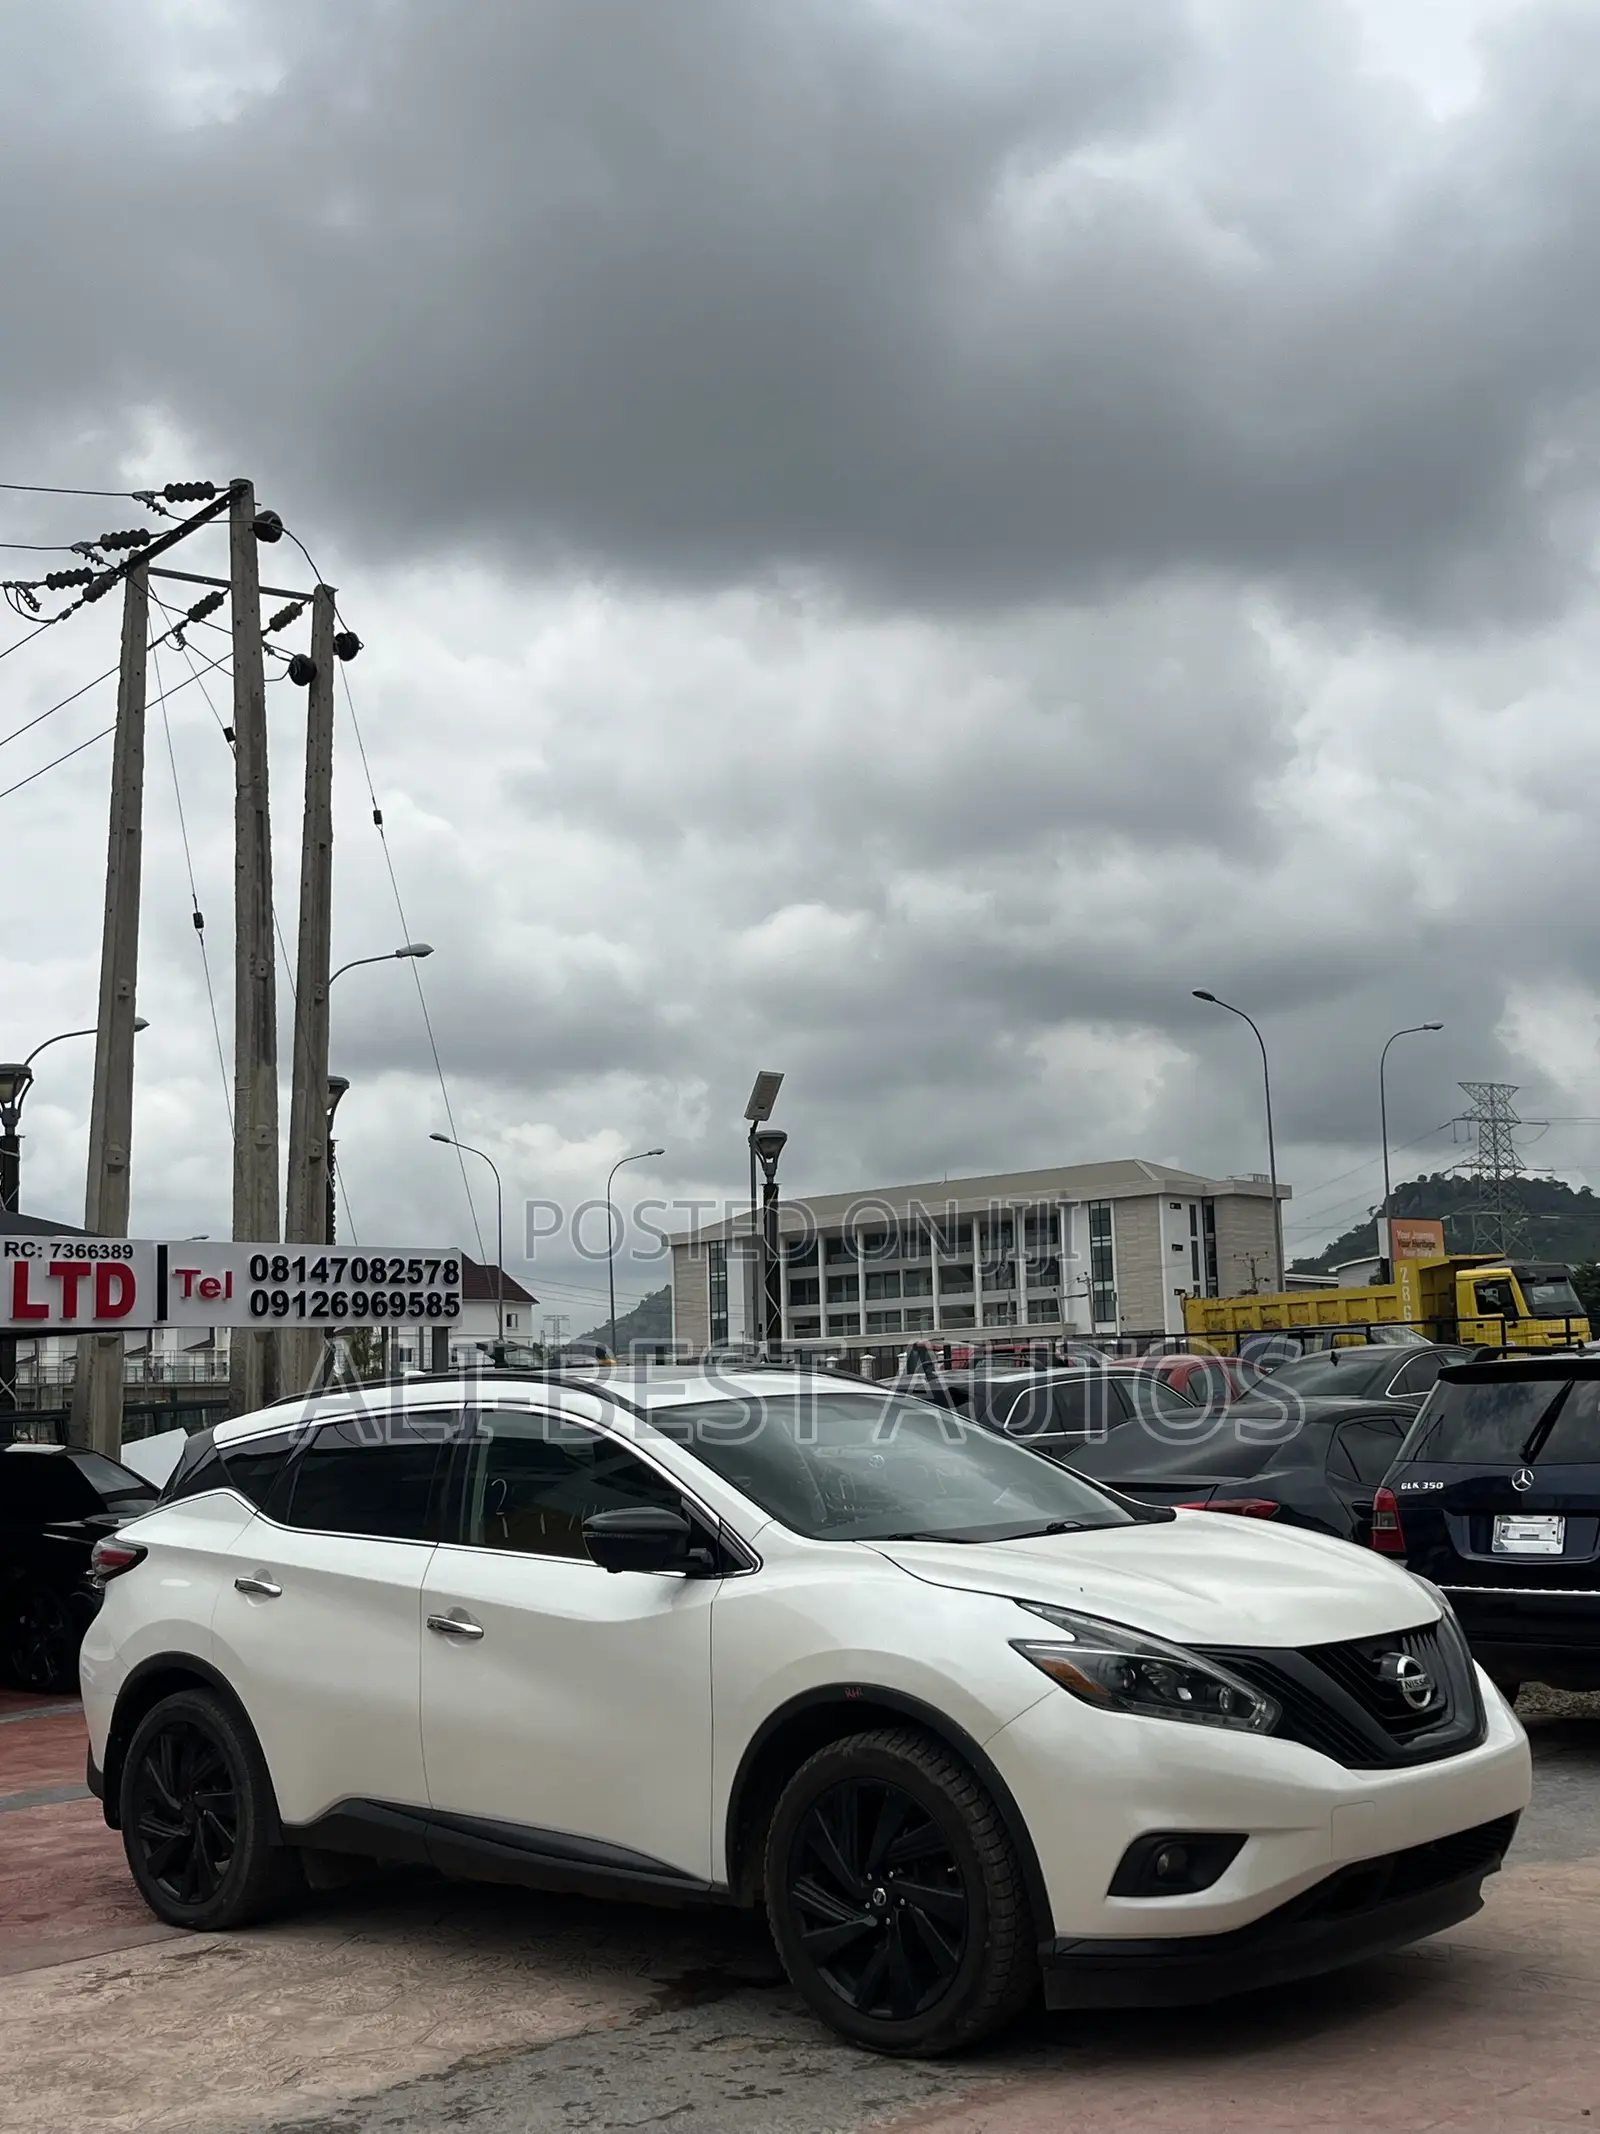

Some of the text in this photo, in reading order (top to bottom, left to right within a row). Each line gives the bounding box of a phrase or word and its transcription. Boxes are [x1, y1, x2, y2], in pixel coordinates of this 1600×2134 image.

[4, 1241, 134, 1259] RC: 7366389
[174, 1269, 232, 1299] Tel
[250, 1254, 460, 1285] 08147082578
[13, 1261, 136, 1319] LTD
[250, 1289, 461, 1318] 09126969585
[1401, 1481, 1444, 1490] GLK 350
